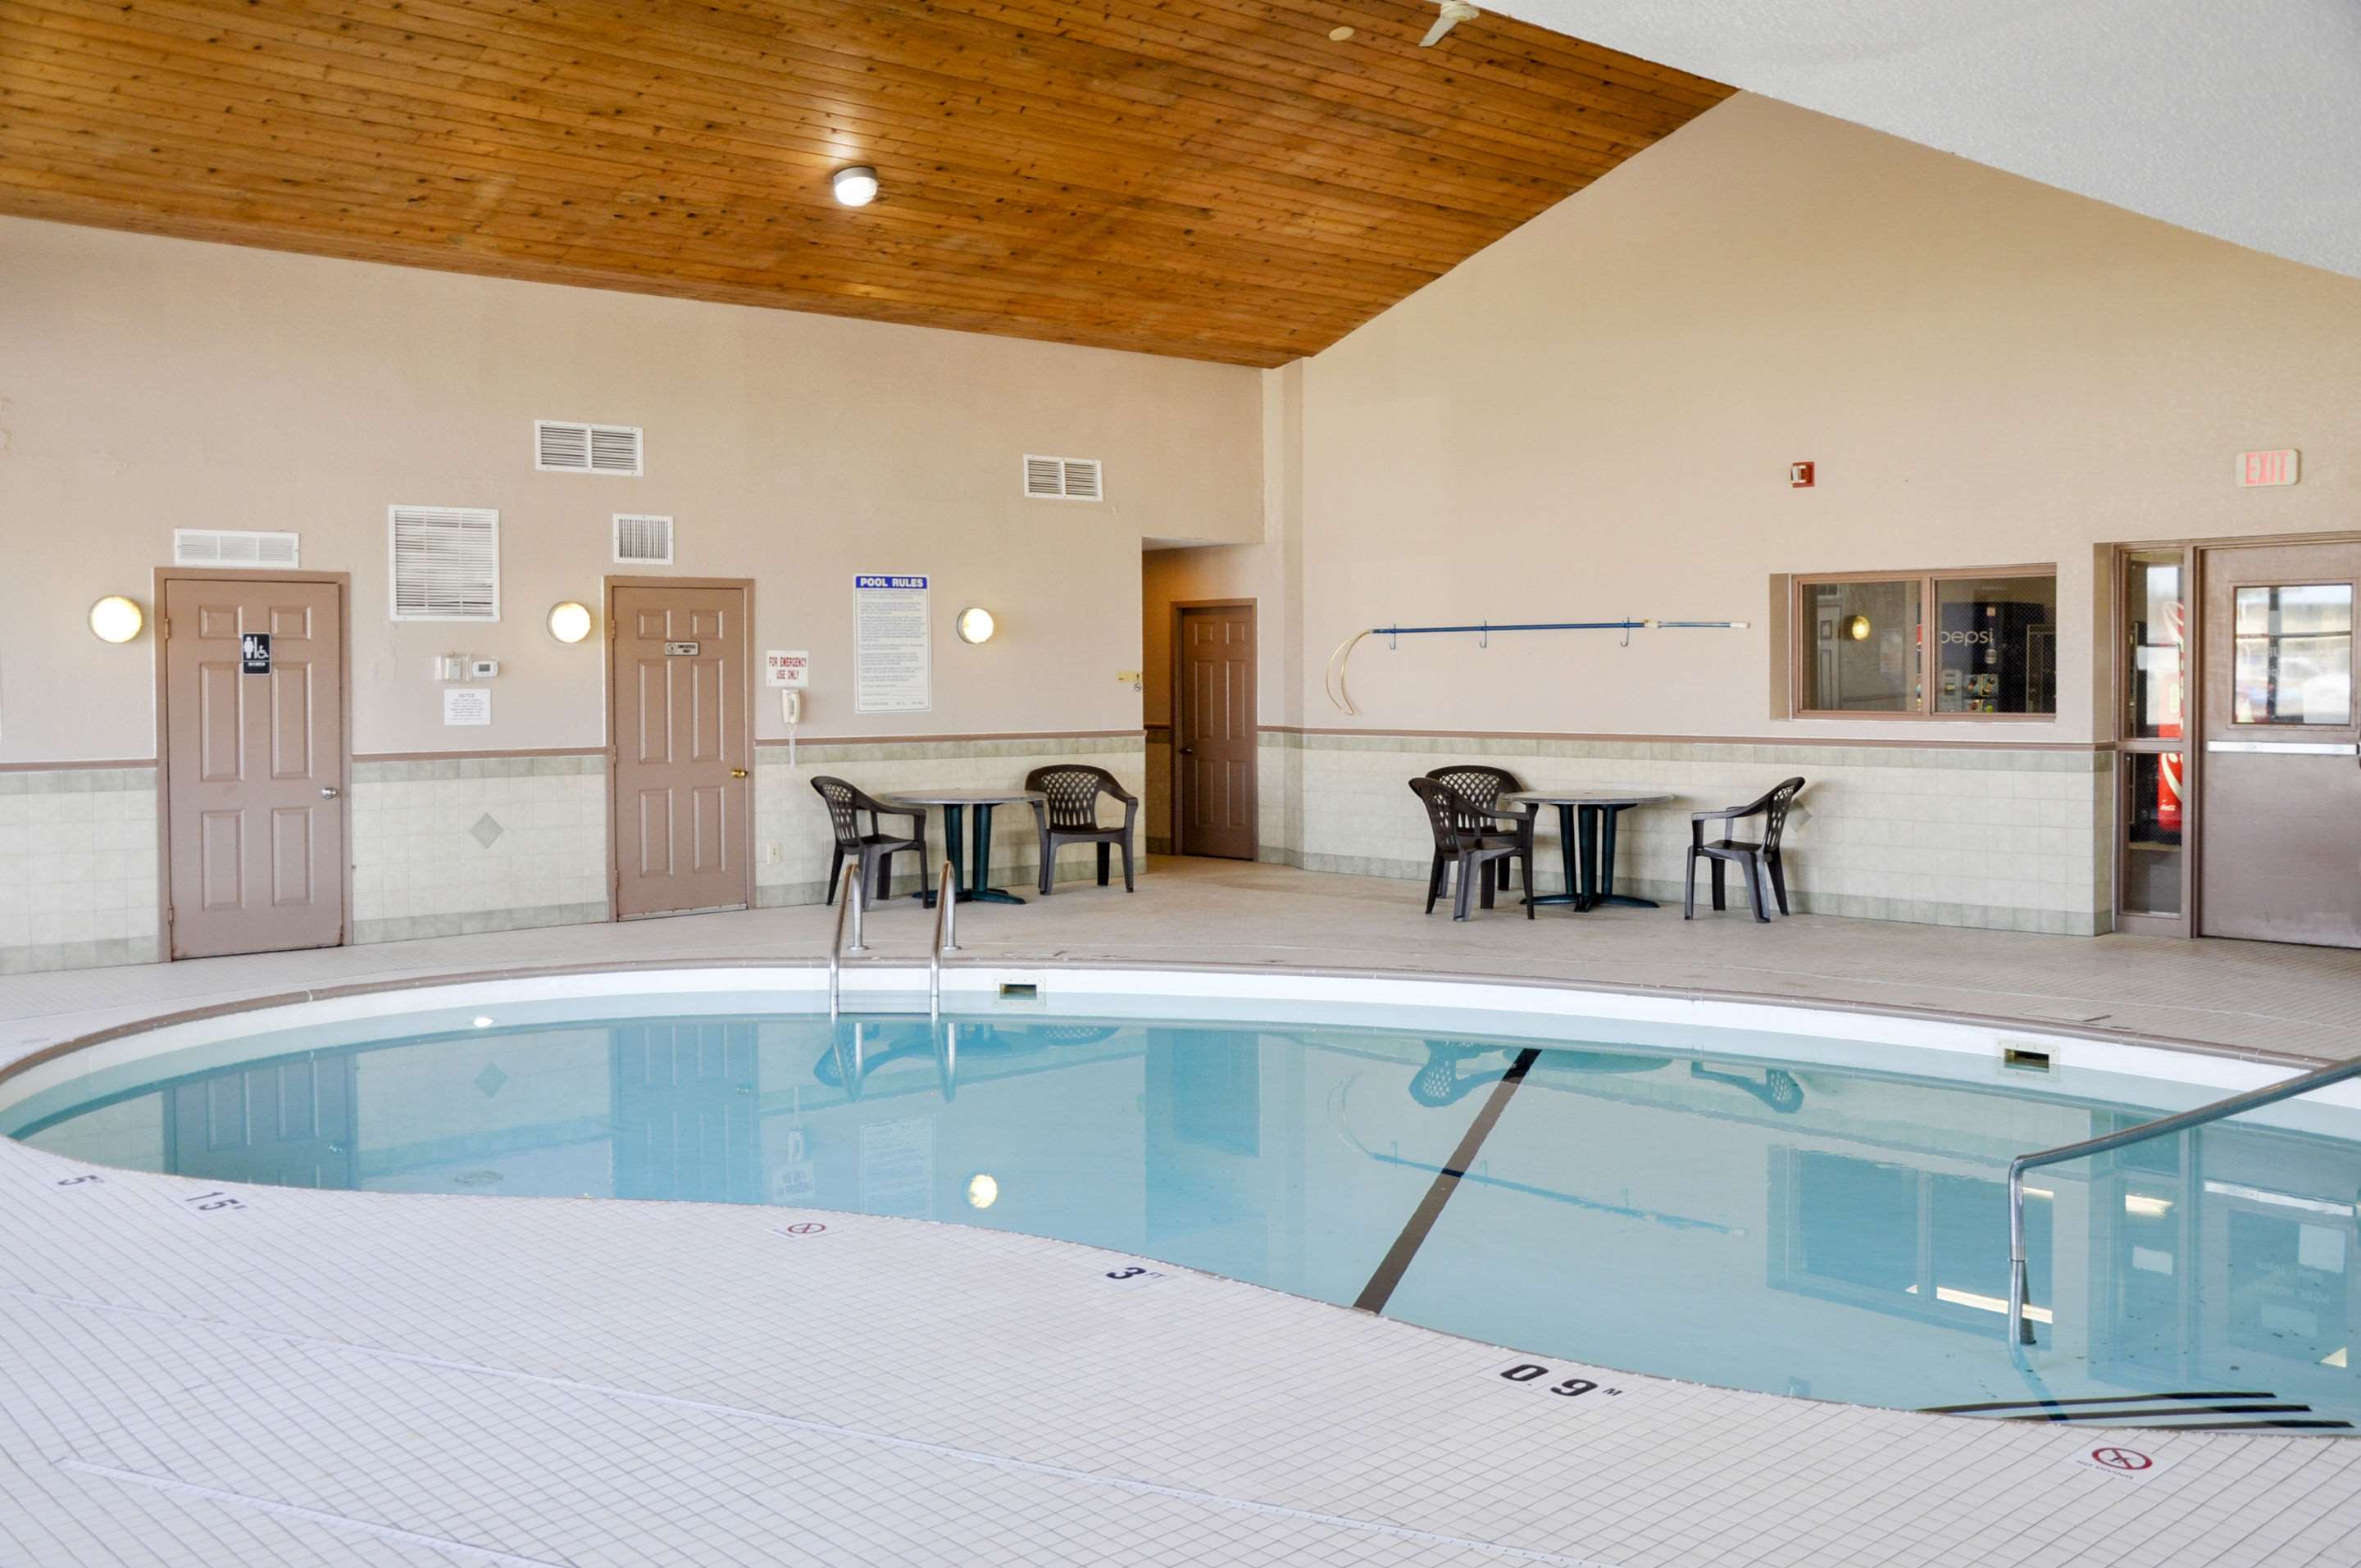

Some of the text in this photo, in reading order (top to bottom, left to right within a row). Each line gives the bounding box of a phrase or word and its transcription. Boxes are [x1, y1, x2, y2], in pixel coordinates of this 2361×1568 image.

[2245, 451, 2288, 485] EXIT
[860, 577, 924, 588] POOL RULES
[1106, 1266, 1147, 1279] 3
